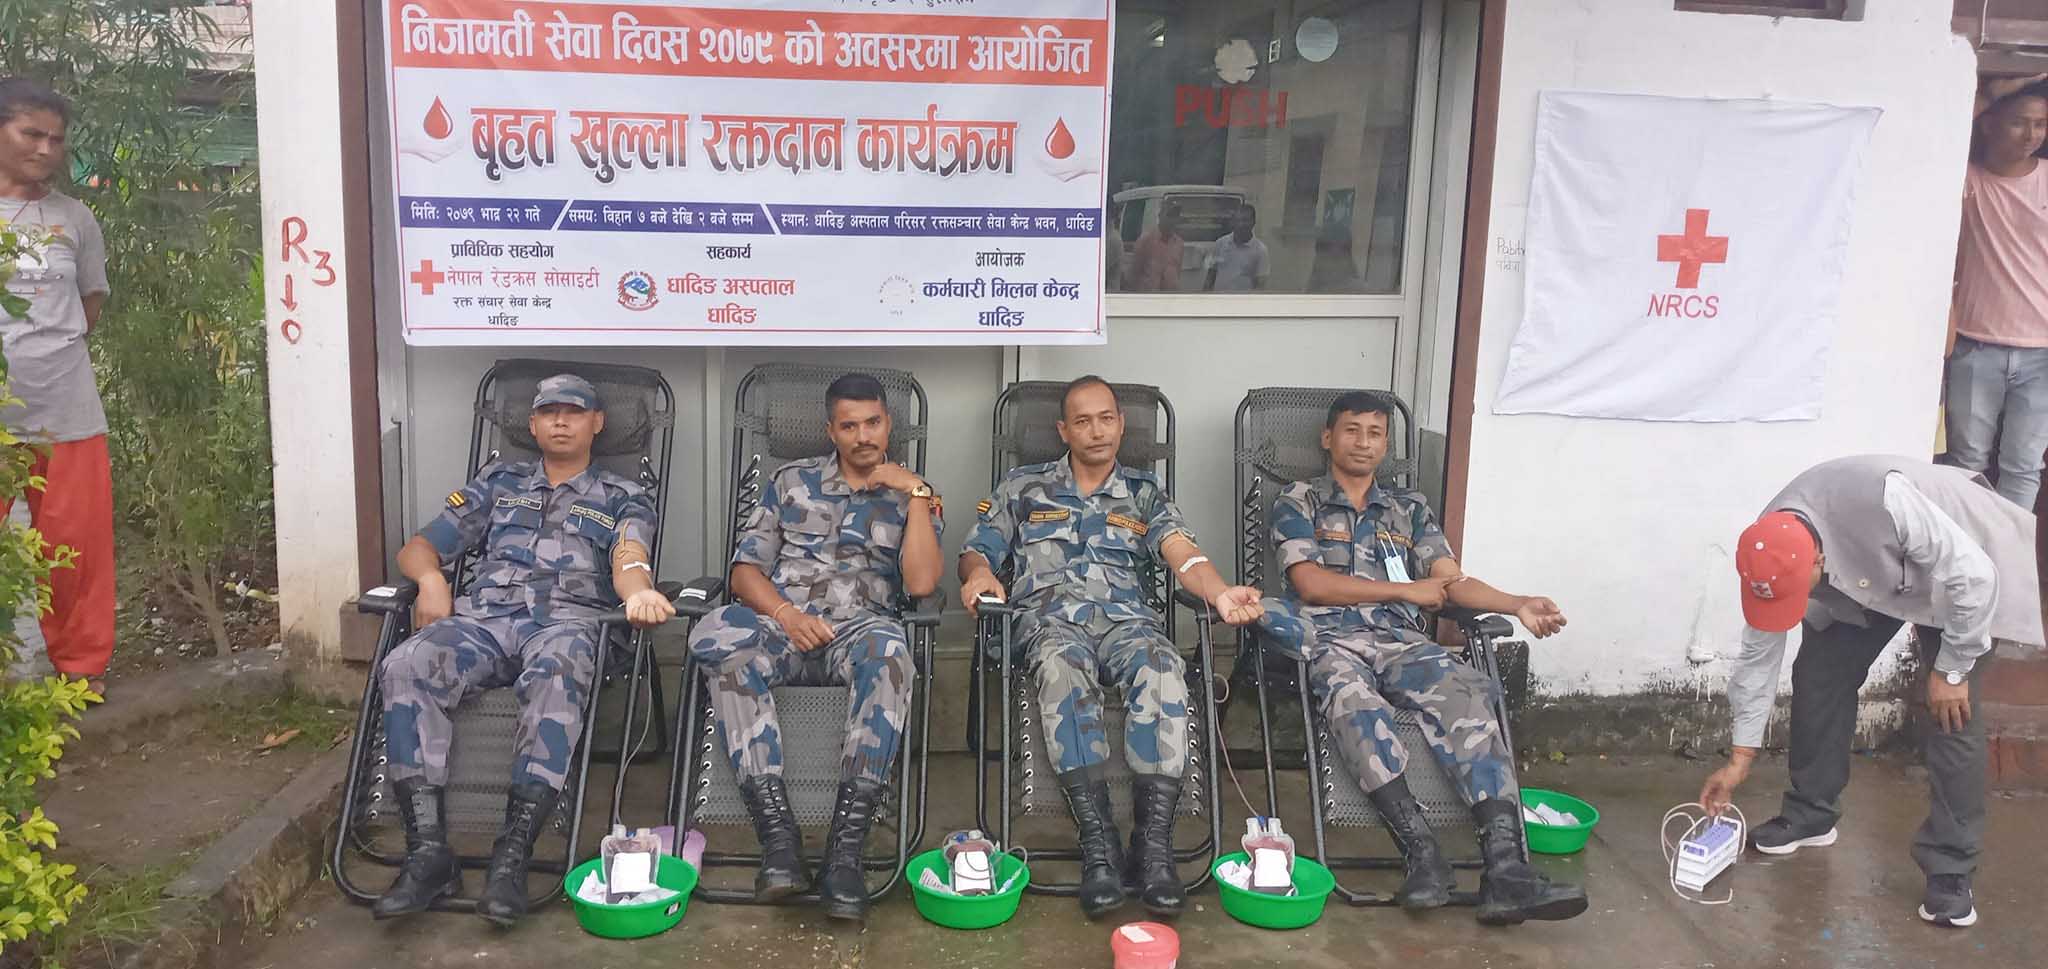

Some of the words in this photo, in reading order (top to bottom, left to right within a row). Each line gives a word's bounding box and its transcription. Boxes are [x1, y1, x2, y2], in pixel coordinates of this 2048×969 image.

[402, 4, 535, 58] निजामती
[545, 10, 603, 61] सेवा
[612, 12, 690, 65] दिवस
[700, 28, 774, 66] २०७९
[784, 19, 826, 67] को
[833, 31, 960, 72] अवसरमा
[968, 25, 1093, 75] आयोजित
[1175, 83, 1289, 129] PUSH
[469, 107, 557, 182] बृहत
[569, 111, 689, 184] खुल्ला
[701, 114, 846, 176] रक्तदान
[857, 104, 1018, 177] कार्यक्रम
[447, 207, 475, 223] २०७९
[480, 206, 501, 222] भाद्र
[506, 208, 520, 223] २२
[524, 205, 541, 223] गते
[637, 211, 646, 223] ७
[672, 206, 693, 226] देखि
[699, 212, 705, 227] २
[731, 212, 754, 226] सम्म
[850, 214, 889, 229] अस्पताल
[894, 211, 926, 229] परिसर
[987, 213, 1005, 230] सेवा
[1010, 213, 1029, 230] केन्द्र
[1035, 216, 1059, 232] भवन,
[451, 240, 504, 258] प्राविधिक
[508, 240, 554, 259] सहयोग
[706, 243, 752, 260] सहकार्य
[975, 248, 1026, 267] आयोजक
[447, 266, 483, 286] नेपाल
[491, 266, 537, 289] रेडक्रस
[544, 266, 600, 290] सोसाइटी
[667, 272, 717, 296] धादिङ
[723, 279, 796, 297] अस्पताल
[923, 277, 986, 299] कर्मचारी
[991, 277, 1038, 299] मिलन
[1043, 278, 1080, 300] केन्द्र
[453, 297, 473, 308] रक्त
[509, 294, 528, 308] सेवा
[532, 295, 552, 309] केन्द्र
[1647, 294, 1720, 319] NRCS
[708, 302, 757, 325] धादिङ
[979, 305, 1025, 328] धादिङ
